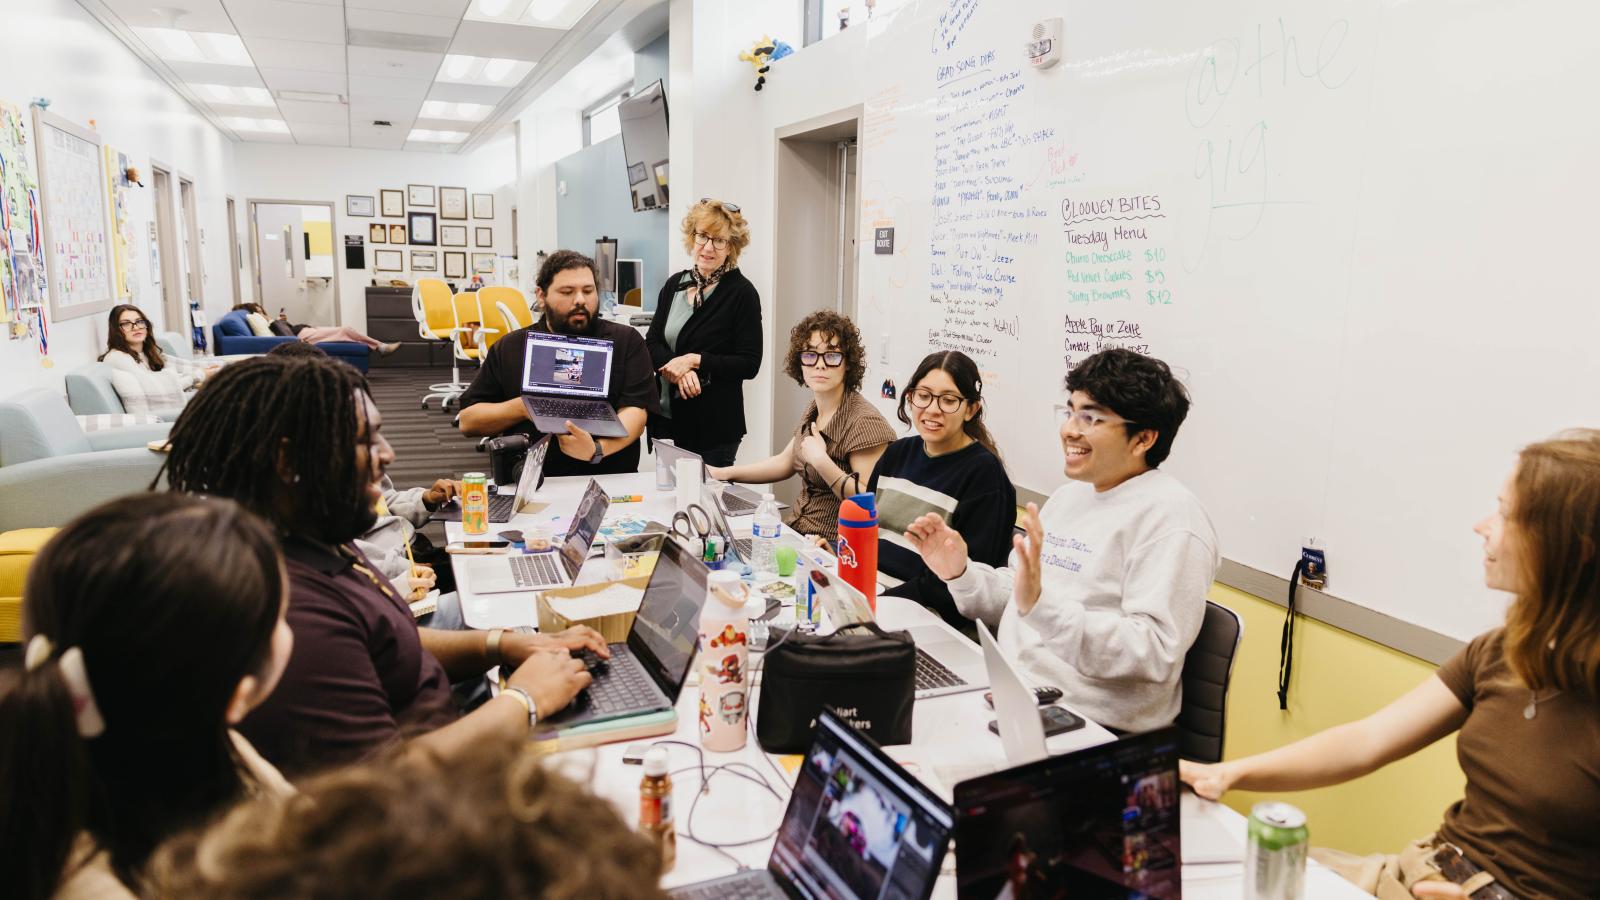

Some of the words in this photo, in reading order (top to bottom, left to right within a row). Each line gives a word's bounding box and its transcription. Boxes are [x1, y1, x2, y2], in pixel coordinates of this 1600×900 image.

[937, 66, 954, 81] GRAD
[957, 55, 976, 73] SONG
[1061, 198, 1114, 221] CLOONEY
[1118, 195, 1162, 213] BITES
[1064, 228, 1109, 252] Tuesday
[1114, 225, 1148, 241] Menu
[1065, 314, 1088, 333] Apple
[1088, 317, 1104, 341] Pay
